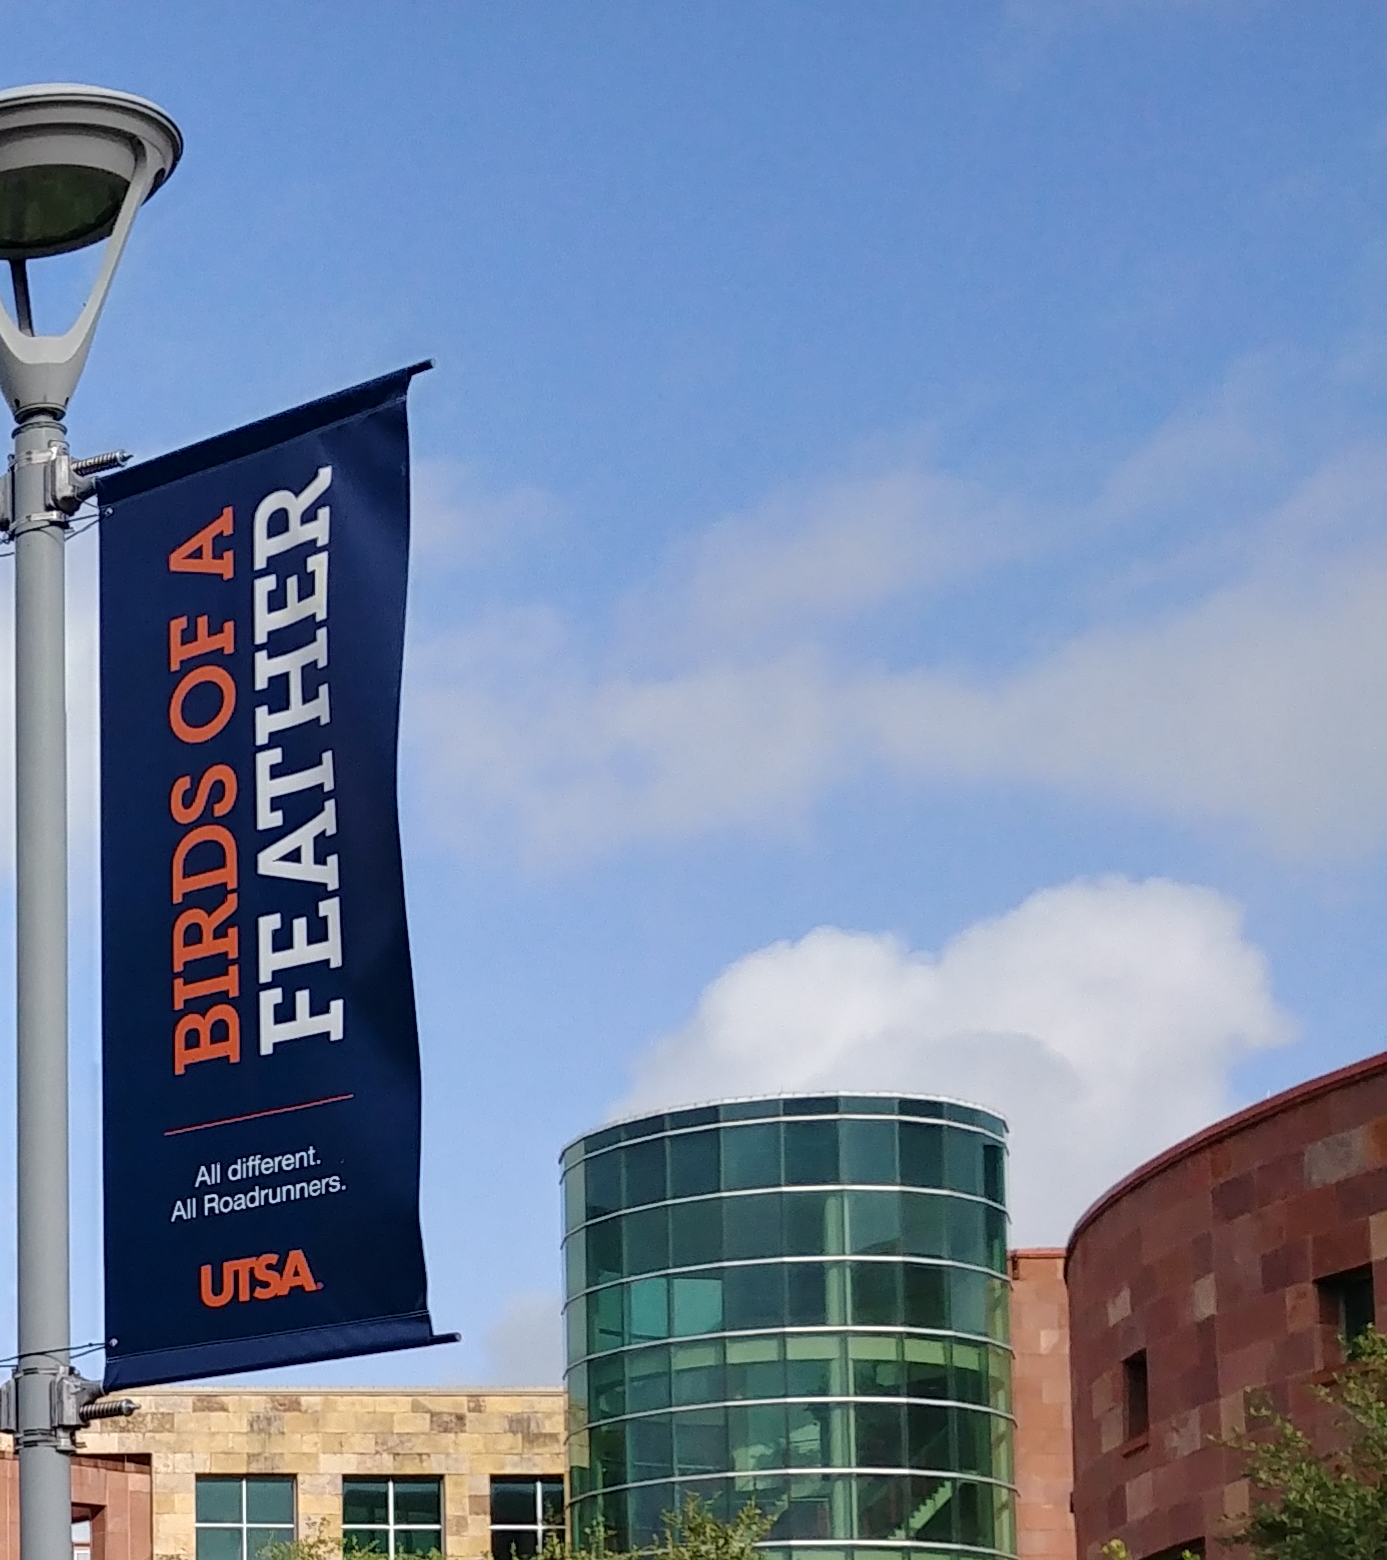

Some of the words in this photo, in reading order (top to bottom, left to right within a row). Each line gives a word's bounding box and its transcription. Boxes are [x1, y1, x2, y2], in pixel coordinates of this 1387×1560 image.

[168, 505, 235, 581] A
[168, 614, 237, 745] OF
[253, 464, 344, 1057] FEATHER
[169, 763, 241, 1076] BIRDS
[170, 1197, 197, 1223] All
[203, 1174, 347, 1217] Roadrunners.
[194, 1161, 221, 1188] All
[227, 1145, 322, 1182] different.
[200, 1248, 318, 1308] UTSA
